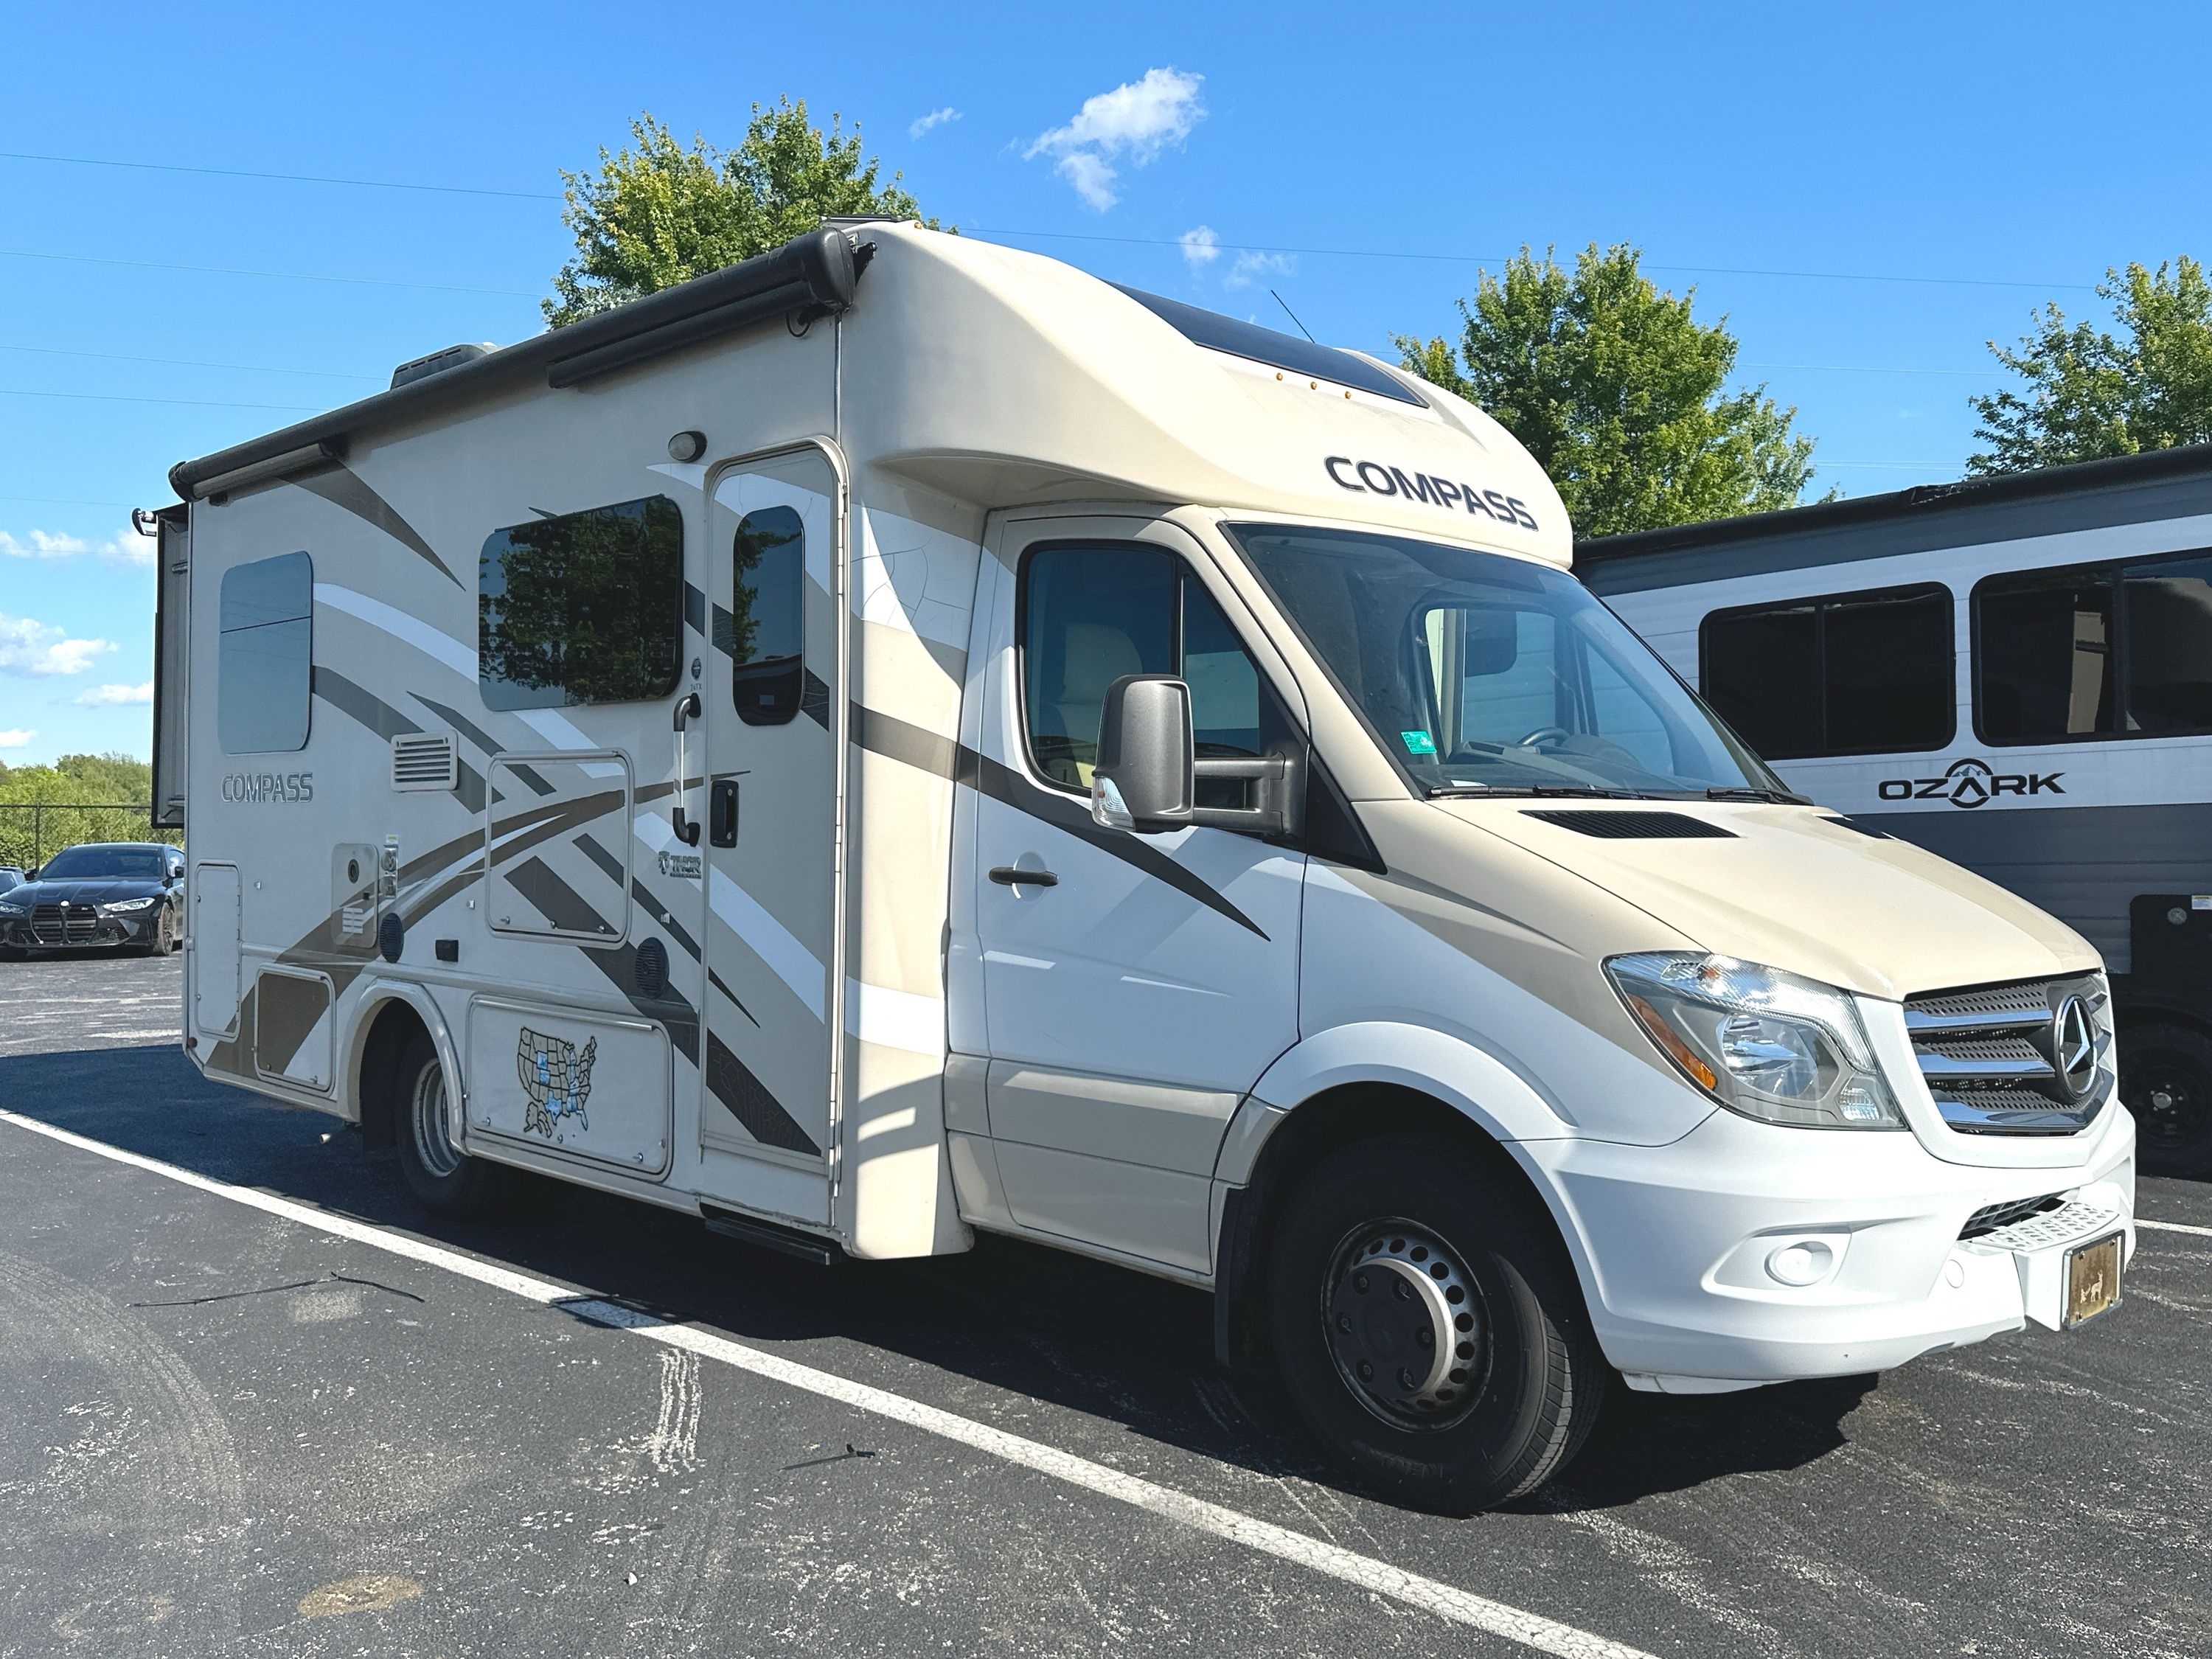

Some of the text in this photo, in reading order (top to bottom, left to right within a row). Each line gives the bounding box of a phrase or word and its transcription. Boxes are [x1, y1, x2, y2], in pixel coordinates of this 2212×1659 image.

[1324, 455, 1539, 532] COMPASS
[221, 772, 313, 803] COMPASS
[1878, 771, 2067, 800] OZARK
